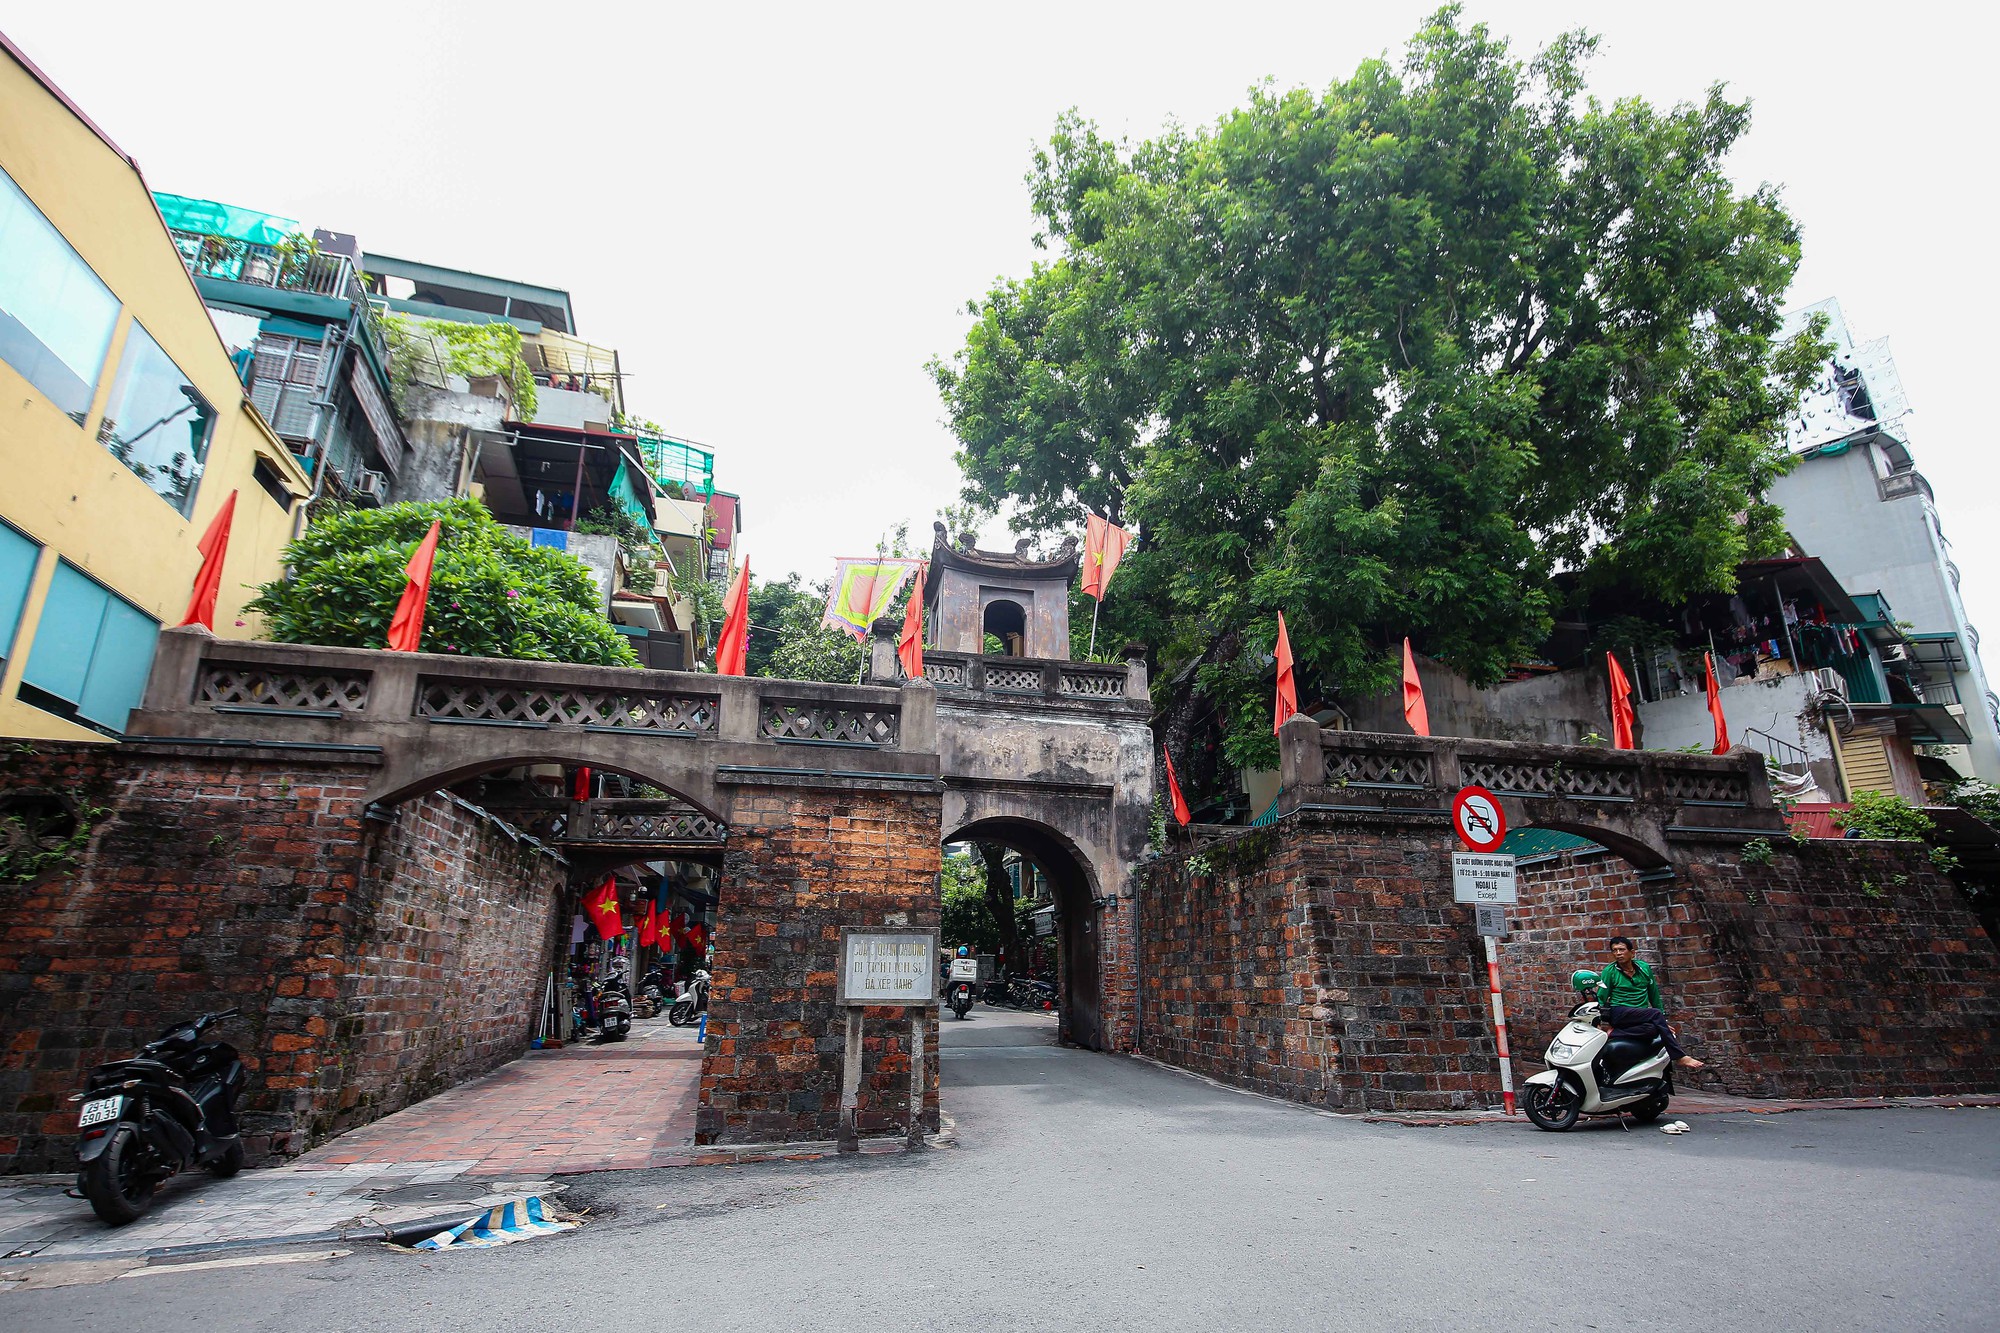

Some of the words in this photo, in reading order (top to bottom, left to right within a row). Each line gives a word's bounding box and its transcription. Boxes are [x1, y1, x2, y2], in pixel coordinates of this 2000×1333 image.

[1478, 891, 1497, 900] Except
[86, 1098, 116, 1114] 29-C1
[81, 1108, 118, 1125] 590.35
